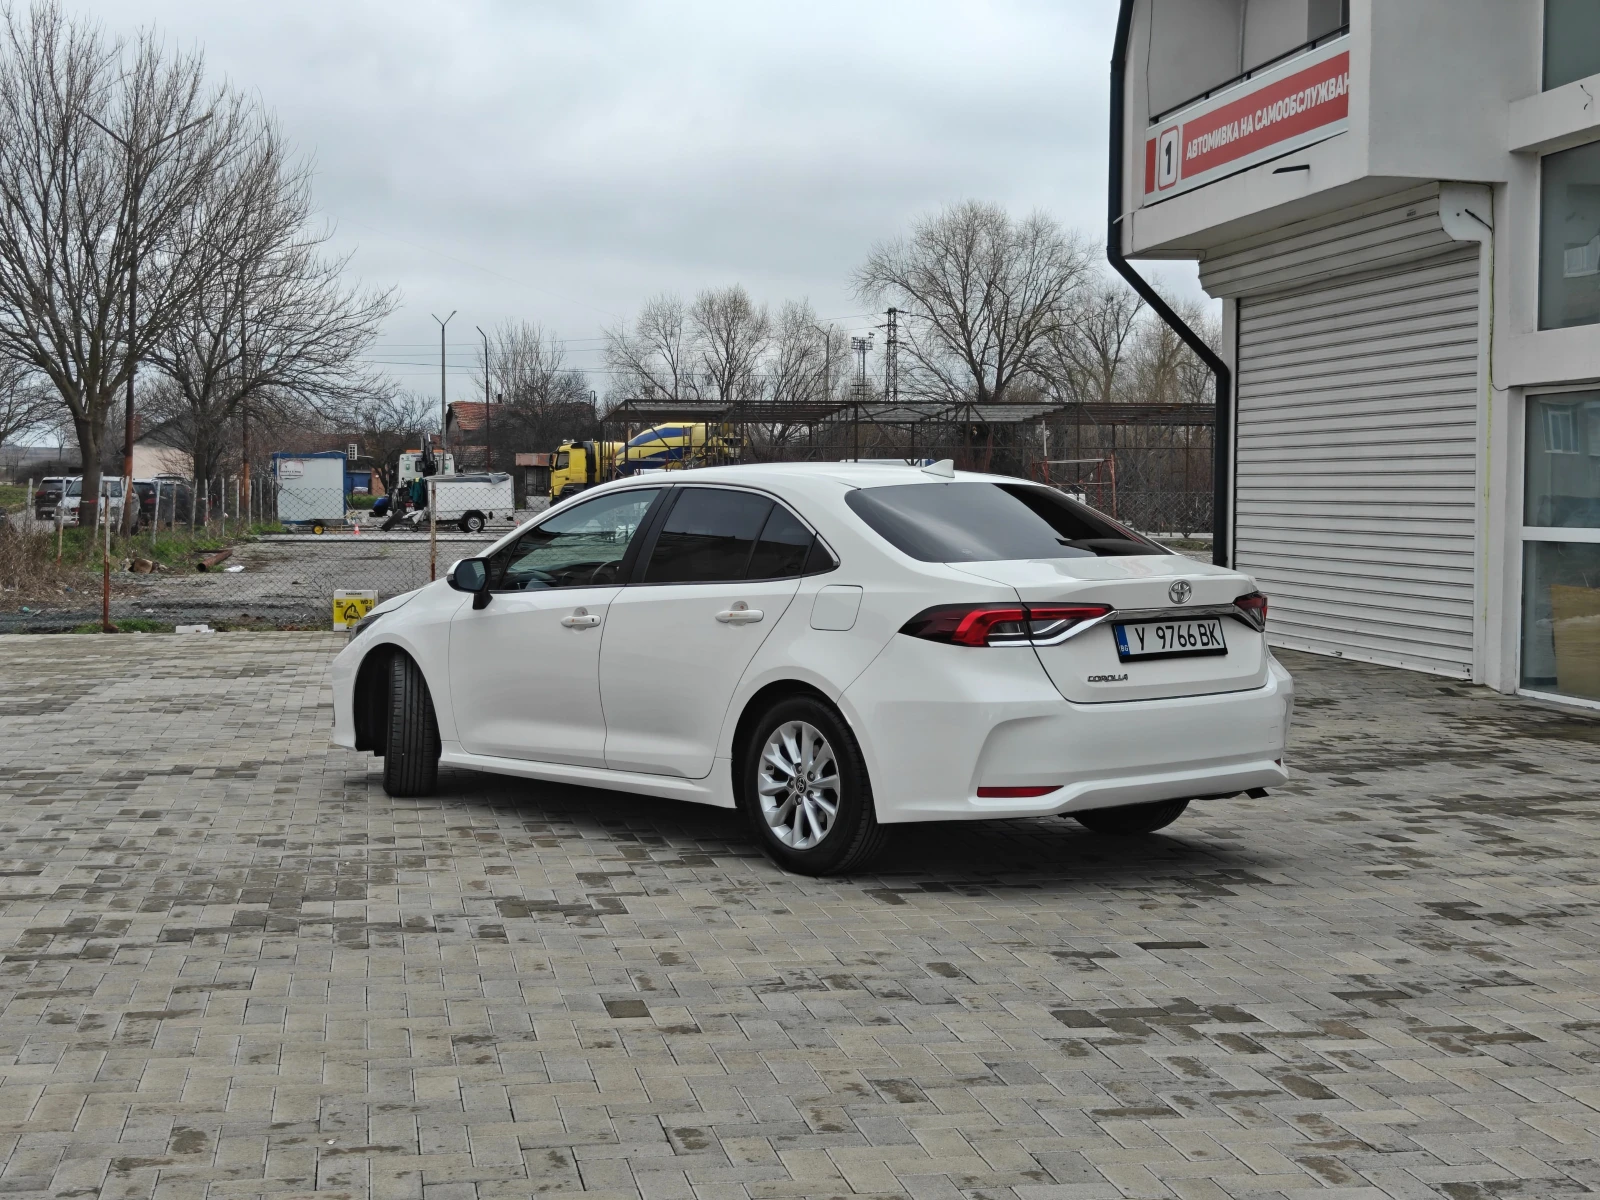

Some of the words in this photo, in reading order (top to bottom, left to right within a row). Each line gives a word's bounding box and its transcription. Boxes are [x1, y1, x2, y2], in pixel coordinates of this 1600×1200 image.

[1165, 140, 1172, 175] 1
[1186, 126, 1239, 161] АВТОМИВКА
[1240, 116, 1254, 138] НА
[1254, 72, 1351, 131] САМООБСЛУЖВАН
[1120, 644, 1129, 652] BG
[1087, 673, 1129, 682] COROLLA
